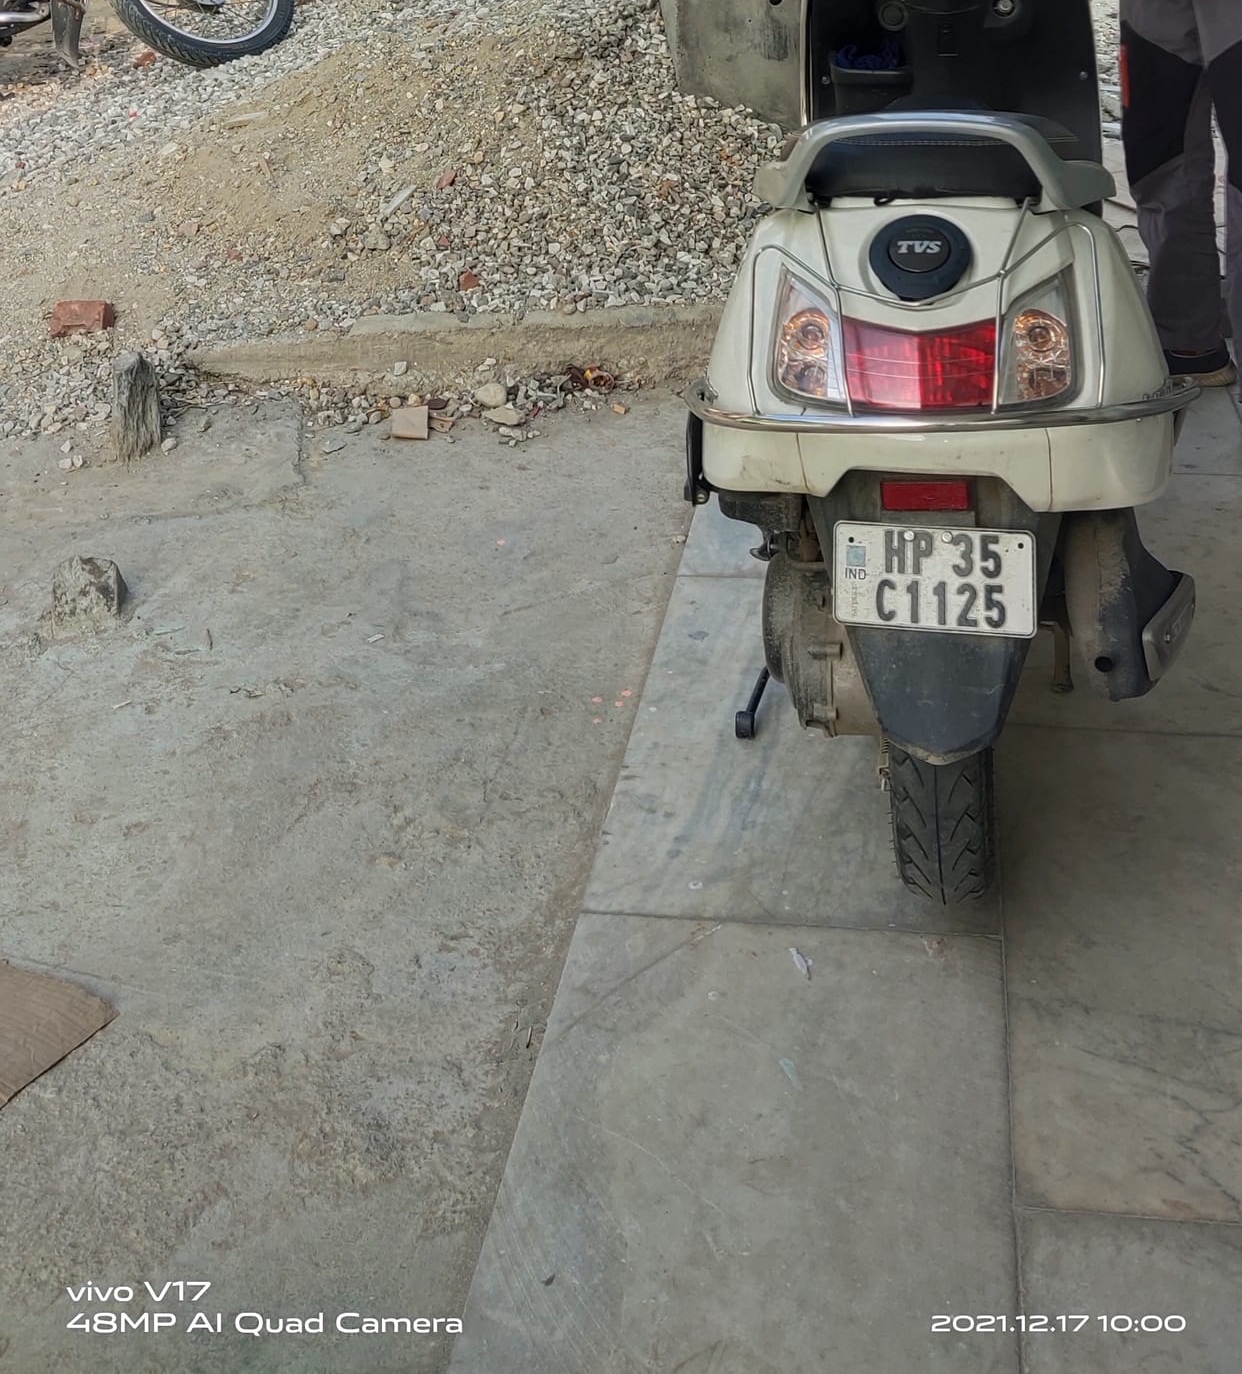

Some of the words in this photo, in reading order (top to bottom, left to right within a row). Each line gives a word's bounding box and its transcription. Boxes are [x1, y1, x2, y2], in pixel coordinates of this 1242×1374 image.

[897, 240, 942, 254] TVS
[884, 529, 933, 575] HP
[952, 532, 1001, 579] 35
[844, 567, 867, 581] IND
[875, 578, 1006, 629] C1125
